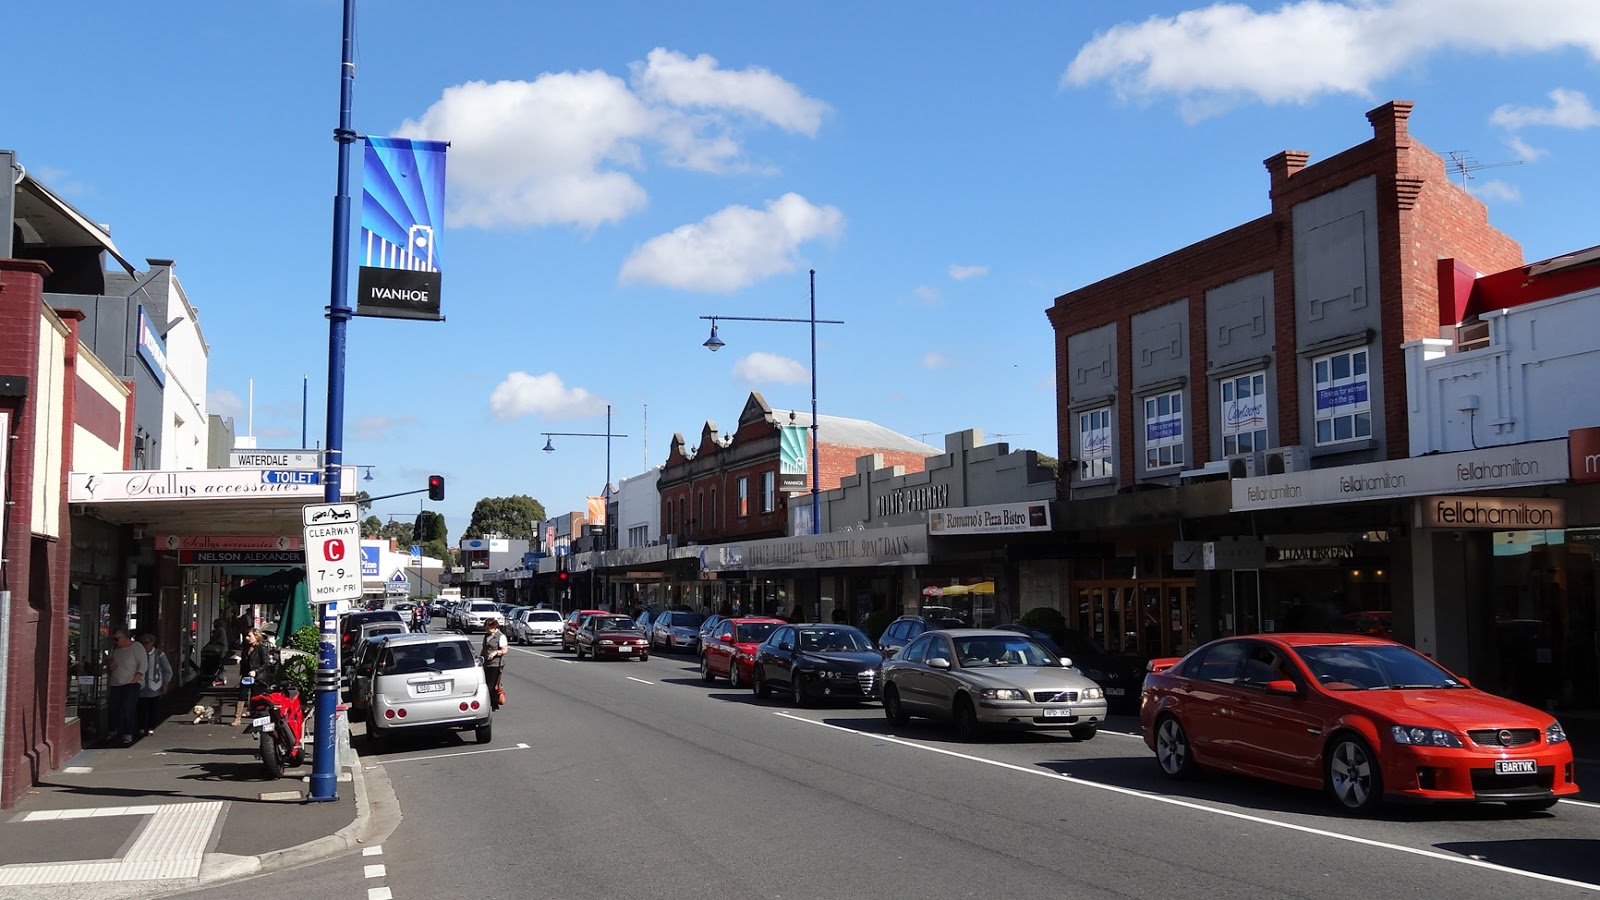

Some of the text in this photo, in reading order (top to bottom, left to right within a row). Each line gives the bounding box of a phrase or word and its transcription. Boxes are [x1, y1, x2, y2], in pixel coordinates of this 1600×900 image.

[371, 287, 429, 302] IVANHOE
[237, 454, 288, 466] WATERDALE
[1457, 457, 1539, 482] fellahamilton
[125, 473, 196, 497] Scullys
[274, 471, 314, 483] TOILET
[1339, 472, 1406, 493] fellahamilton
[1247, 484, 1302, 502] fellahamilton
[946, 510, 983, 529] Romano's
[1002, 509, 1026, 526] Bistro
[1437, 501, 1553, 525] fellahamilton
[308, 526, 355, 538] CLEARWAY
[198, 552, 300, 561] NELSON ALEXANDER
[328, 540, 340, 560] C
[814, 541, 836, 560] OPEN
[884, 536, 910, 556] DAYS
[1502, 761, 1534, 772] BARTVK
